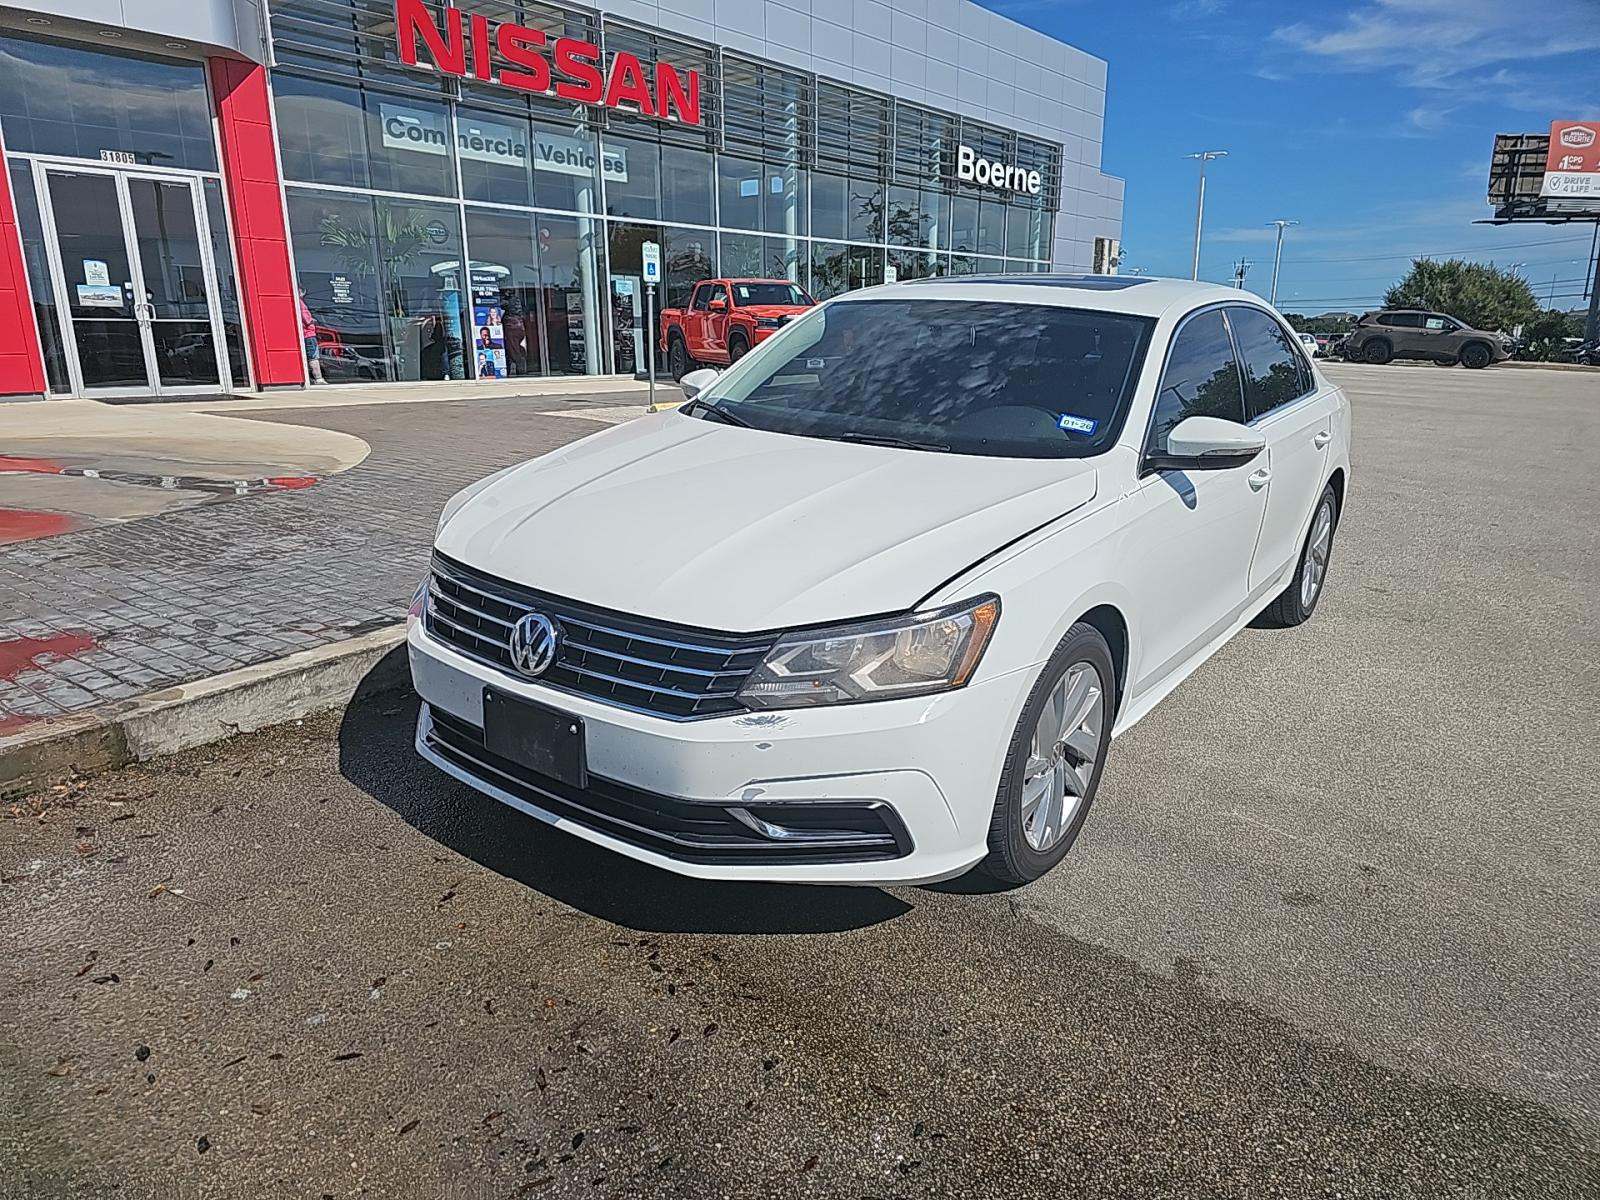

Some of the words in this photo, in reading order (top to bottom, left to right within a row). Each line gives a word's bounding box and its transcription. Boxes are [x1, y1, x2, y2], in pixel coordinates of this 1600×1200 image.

[396, 0, 700, 125] NISSAN
[386, 117, 528, 158] Commercia
[538, 143, 624, 173] Vehices
[101, 150, 134, 165] 31805
[958, 145, 1041, 194] Boerne
[1563, 175, 1591, 185] DRIVE
[1563, 184, 1569, 193] 4
[1570, 185, 1590, 193] LIFE
[1063, 419, 1092, 430] 01-26
